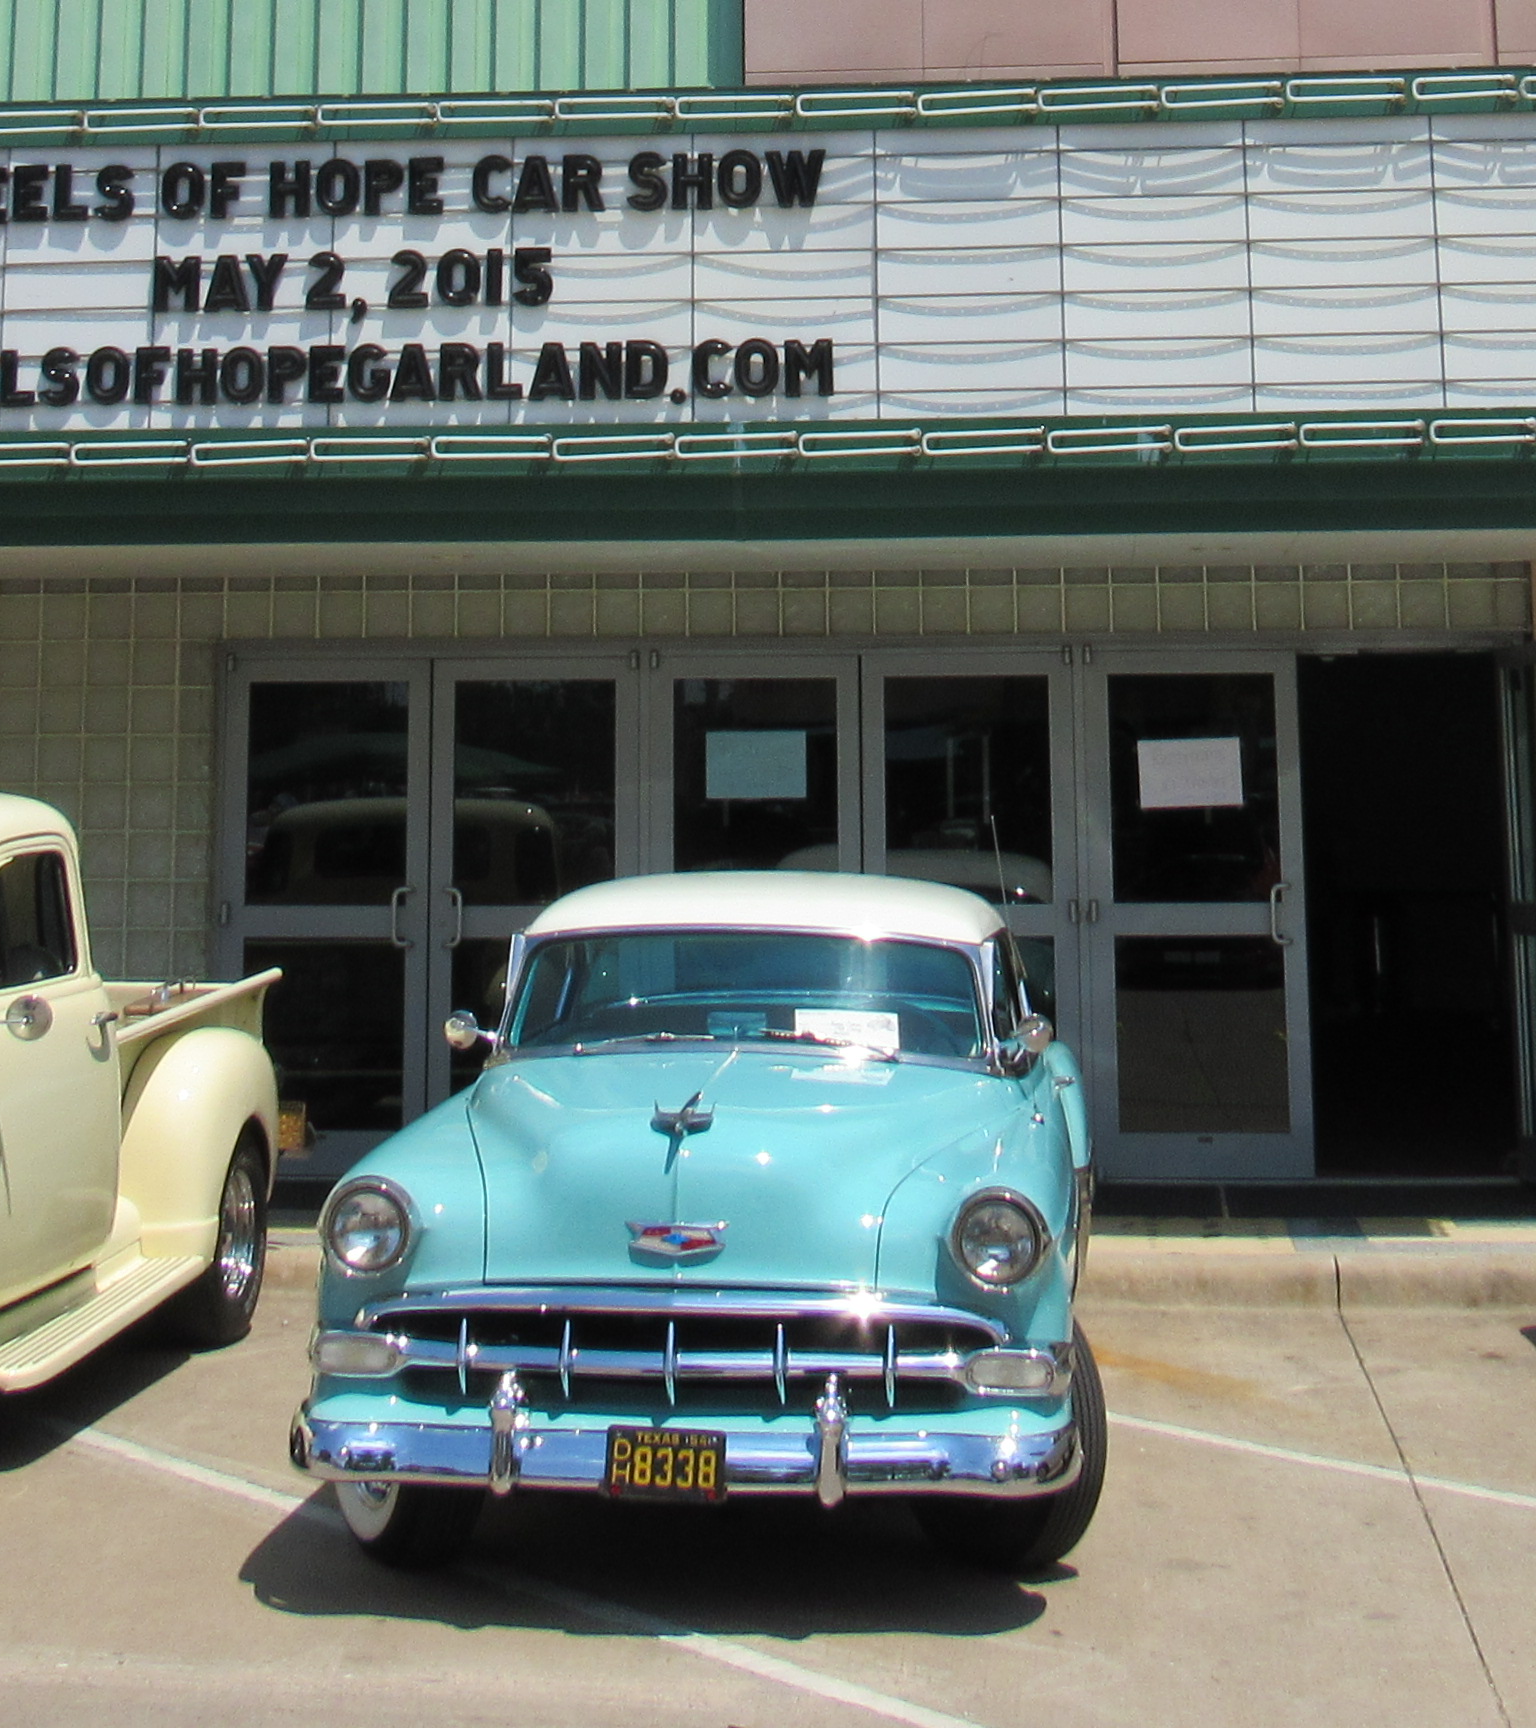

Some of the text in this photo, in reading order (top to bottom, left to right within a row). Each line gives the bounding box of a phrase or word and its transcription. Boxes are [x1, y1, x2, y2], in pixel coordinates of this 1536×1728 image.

[162, 160, 247, 220] OF
[269, 156, 445, 219] HOPE
[471, 154, 605, 215] CAR
[626, 148, 826, 211] SHOW
[152, 247, 554, 325] MAY 2, 2015
[635, 1430, 680, 1445] TEXAS
[633, 1445, 717, 1489] 8338
